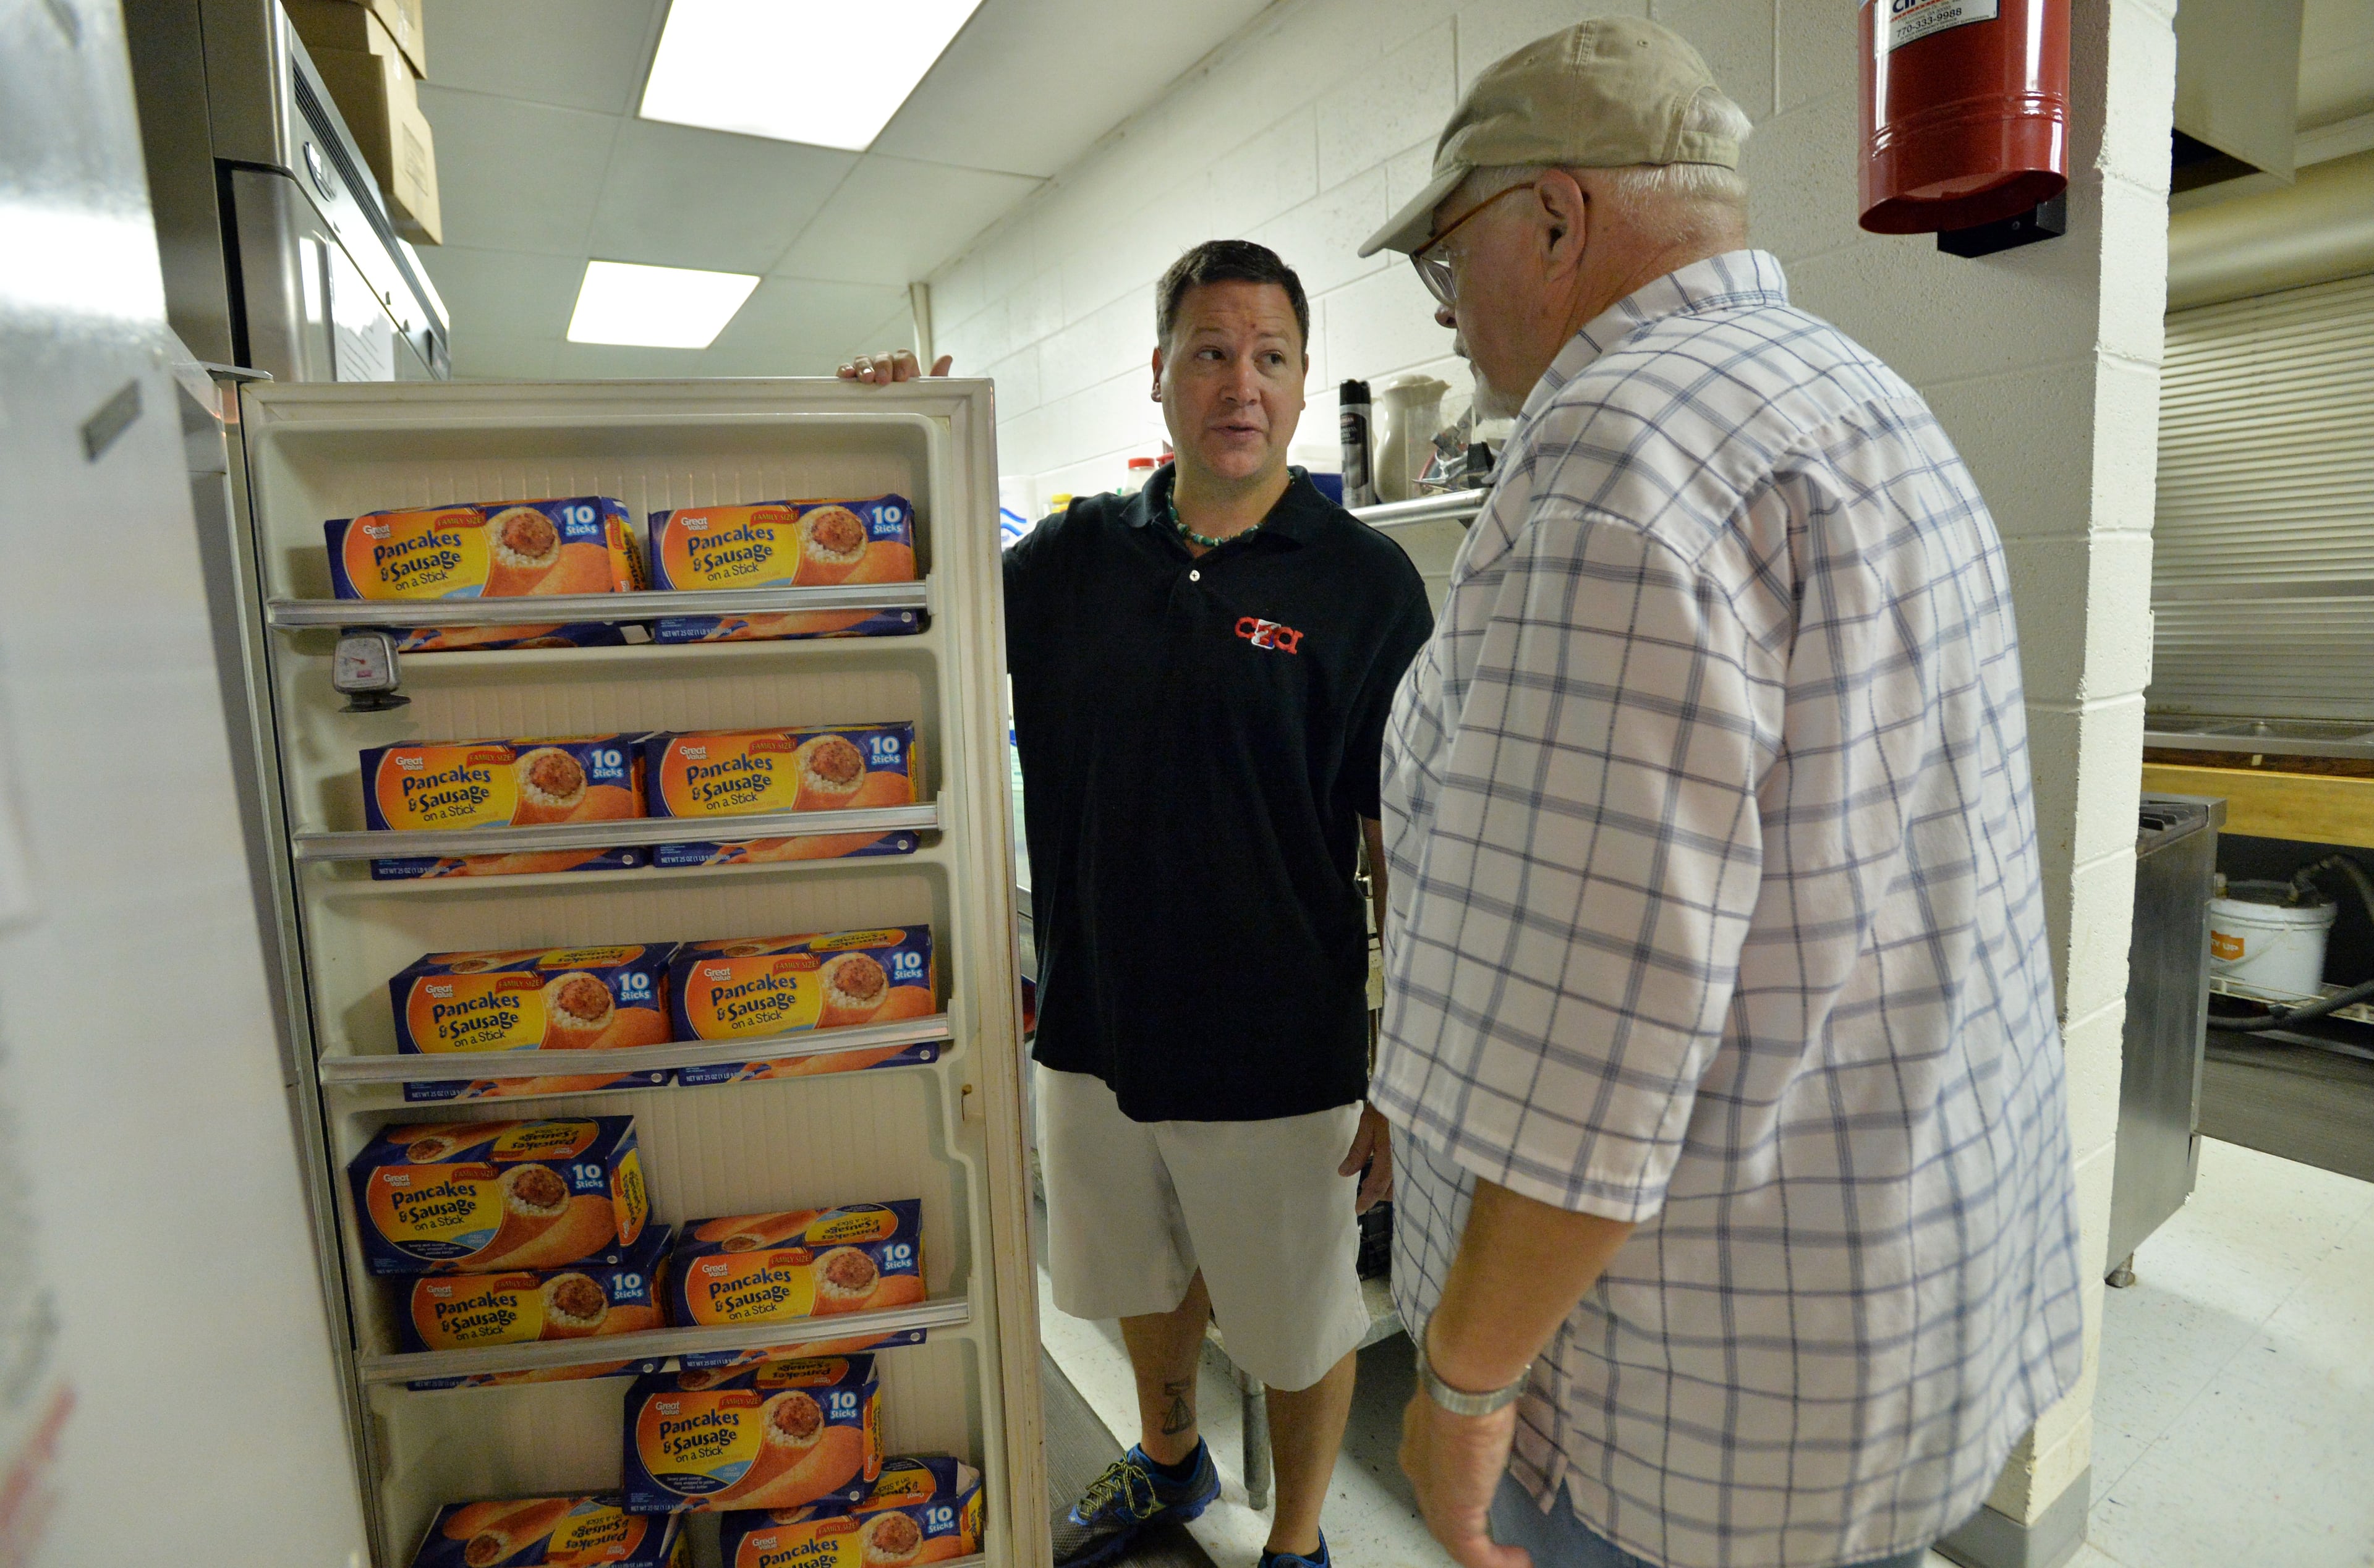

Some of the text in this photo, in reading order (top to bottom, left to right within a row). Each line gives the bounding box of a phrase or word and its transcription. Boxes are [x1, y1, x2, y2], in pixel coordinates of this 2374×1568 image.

[1896, 7, 1962, 38] 770-333-9988
[563, 506, 595, 525] 10
[681, 517, 707, 527] Great
[872, 507, 901, 524] 10
[566, 525, 598, 535] Sticks
[874, 524, 902, 533] Sticks
[373, 530, 462, 567] Pancakes
[687, 523, 775, 556] Pancakes
[381, 551, 461, 583] & Sausage
[694, 543, 772, 573] & Sausage
[396, 581, 411, 591] on
[419, 570, 449, 584] Stick
[707, 562, 759, 582] on a Stick
[680, 745, 707, 755] Great
[870, 737, 900, 754] 10
[396, 756, 423, 766] Great
[592, 750, 621, 767] 10
[872, 754, 900, 763] Sticks
[594, 768, 623, 778] Sticks
[686, 753, 773, 786] Pancakes
[402, 765, 490, 797] Pancakes
[692, 773, 772, 802] & Sausage
[409, 785, 490, 813] & Sausage
[707, 791, 758, 810] on a Stick
[423, 803, 476, 821] on a Stick
[2223, 942, 2239, 951] UP
[893, 952, 921, 970] 10
[704, 968, 731, 977] Great
[894, 970, 922, 979] Sticks
[425, 984, 453, 994] Great
[619, 973, 649, 991] 10
[711, 973, 797, 1006] Pancakes
[621, 991, 650, 1000] Sticks
[433, 991, 520, 1023] Pancakes
[717, 993, 796, 1022] & Sausage
[439, 1011, 518, 1040] & Sausage
[731, 1020, 745, 1030] on
[755, 1010, 783, 1024] Stick
[454, 1028, 506, 1048] on a Stick
[383, 1174, 410, 1183] Great
[572, 1164, 602, 1180] 10
[576, 1180, 604, 1189] Sticks
[391, 1181, 477, 1210] Pancakes
[399, 1199, 476, 1224] & Sausage
[414, 1214, 466, 1232] on a Stick
[883, 1245, 911, 1261] 10
[702, 1263, 728, 1273] Great
[885, 1259, 911, 1269] Sticks
[613, 1274, 641, 1290] 10
[709, 1267, 791, 1300] Pancakes
[615, 1289, 642, 1299] Sticks
[715, 1285, 791, 1313] & Sausage
[435, 1292, 517, 1319] Pancakes
[729, 1302, 777, 1320] on a Stick
[453, 1309, 517, 1334] Sausage
[456, 1332, 469, 1341] on
[479, 1324, 504, 1336] Stick
[655, 1401, 680, 1410] Great
[830, 1392, 856, 1409] 10
[831, 1409, 856, 1418] Sticks
[660, 1409, 739, 1439] Pancakes
[663, 1428, 737, 1455] & Sausage
[676, 1455, 689, 1464] on
[699, 1446, 723, 1459] Stick
[927, 1507, 953, 1525] 10
[571, 1519, 623, 1538] Sausage
[929, 1522, 954, 1533] Sticks
[565, 1528, 628, 1551] Pancakes
[752, 1536, 777, 1546] Great
[758, 1538, 838, 1568] Pancakes
